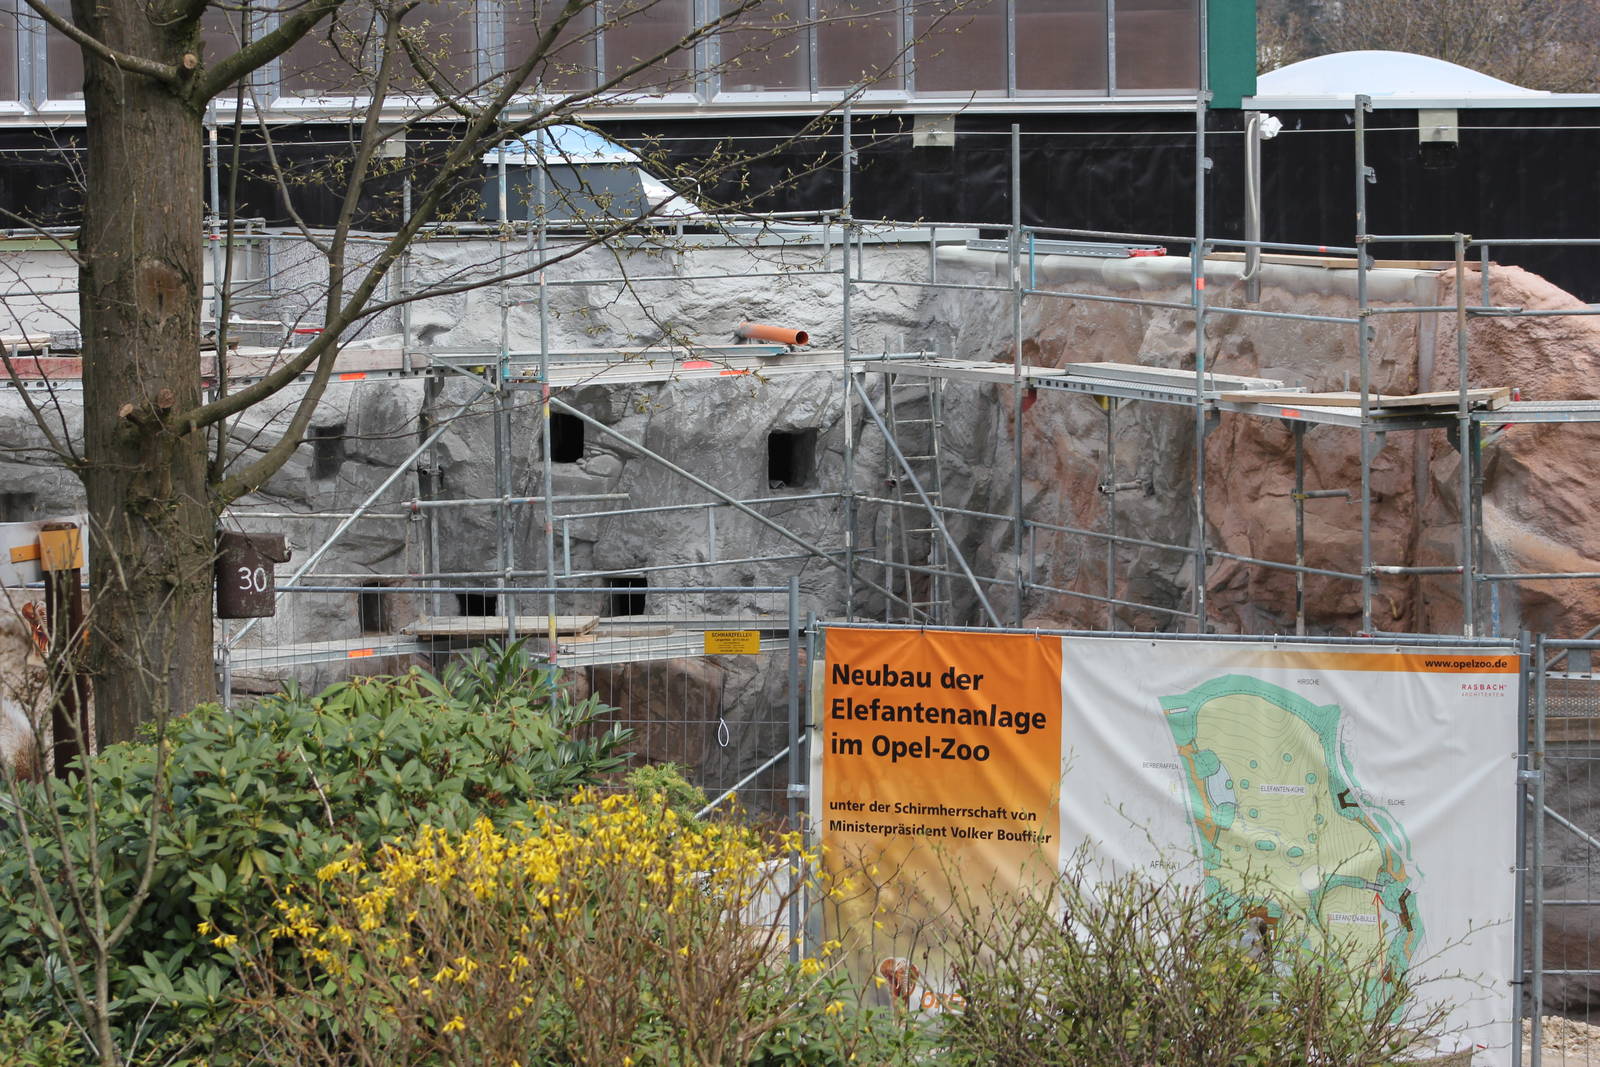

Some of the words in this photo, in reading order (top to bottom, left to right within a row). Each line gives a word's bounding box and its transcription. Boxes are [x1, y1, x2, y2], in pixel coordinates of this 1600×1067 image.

[238, 566, 267, 592] 30
[832, 663, 932, 688] Neubau
[940, 666, 984, 691] der
[1424, 659, 1508, 669] www.opelzoo.de
[832, 697, 1046, 734] Elefantenanlage
[831, 732, 863, 755] im
[872, 735, 990, 763] Opel-Zoo
[829, 800, 865, 812] unter
[869, 801, 891, 813] der
[895, 802, 1008, 819] Schirmherrschaft
[1011, 810, 1037, 821] von
[829, 820, 947, 837] Ministerpräsident
[951, 826, 993, 840] Volker
[997, 829, 1052, 844] Bouffier
